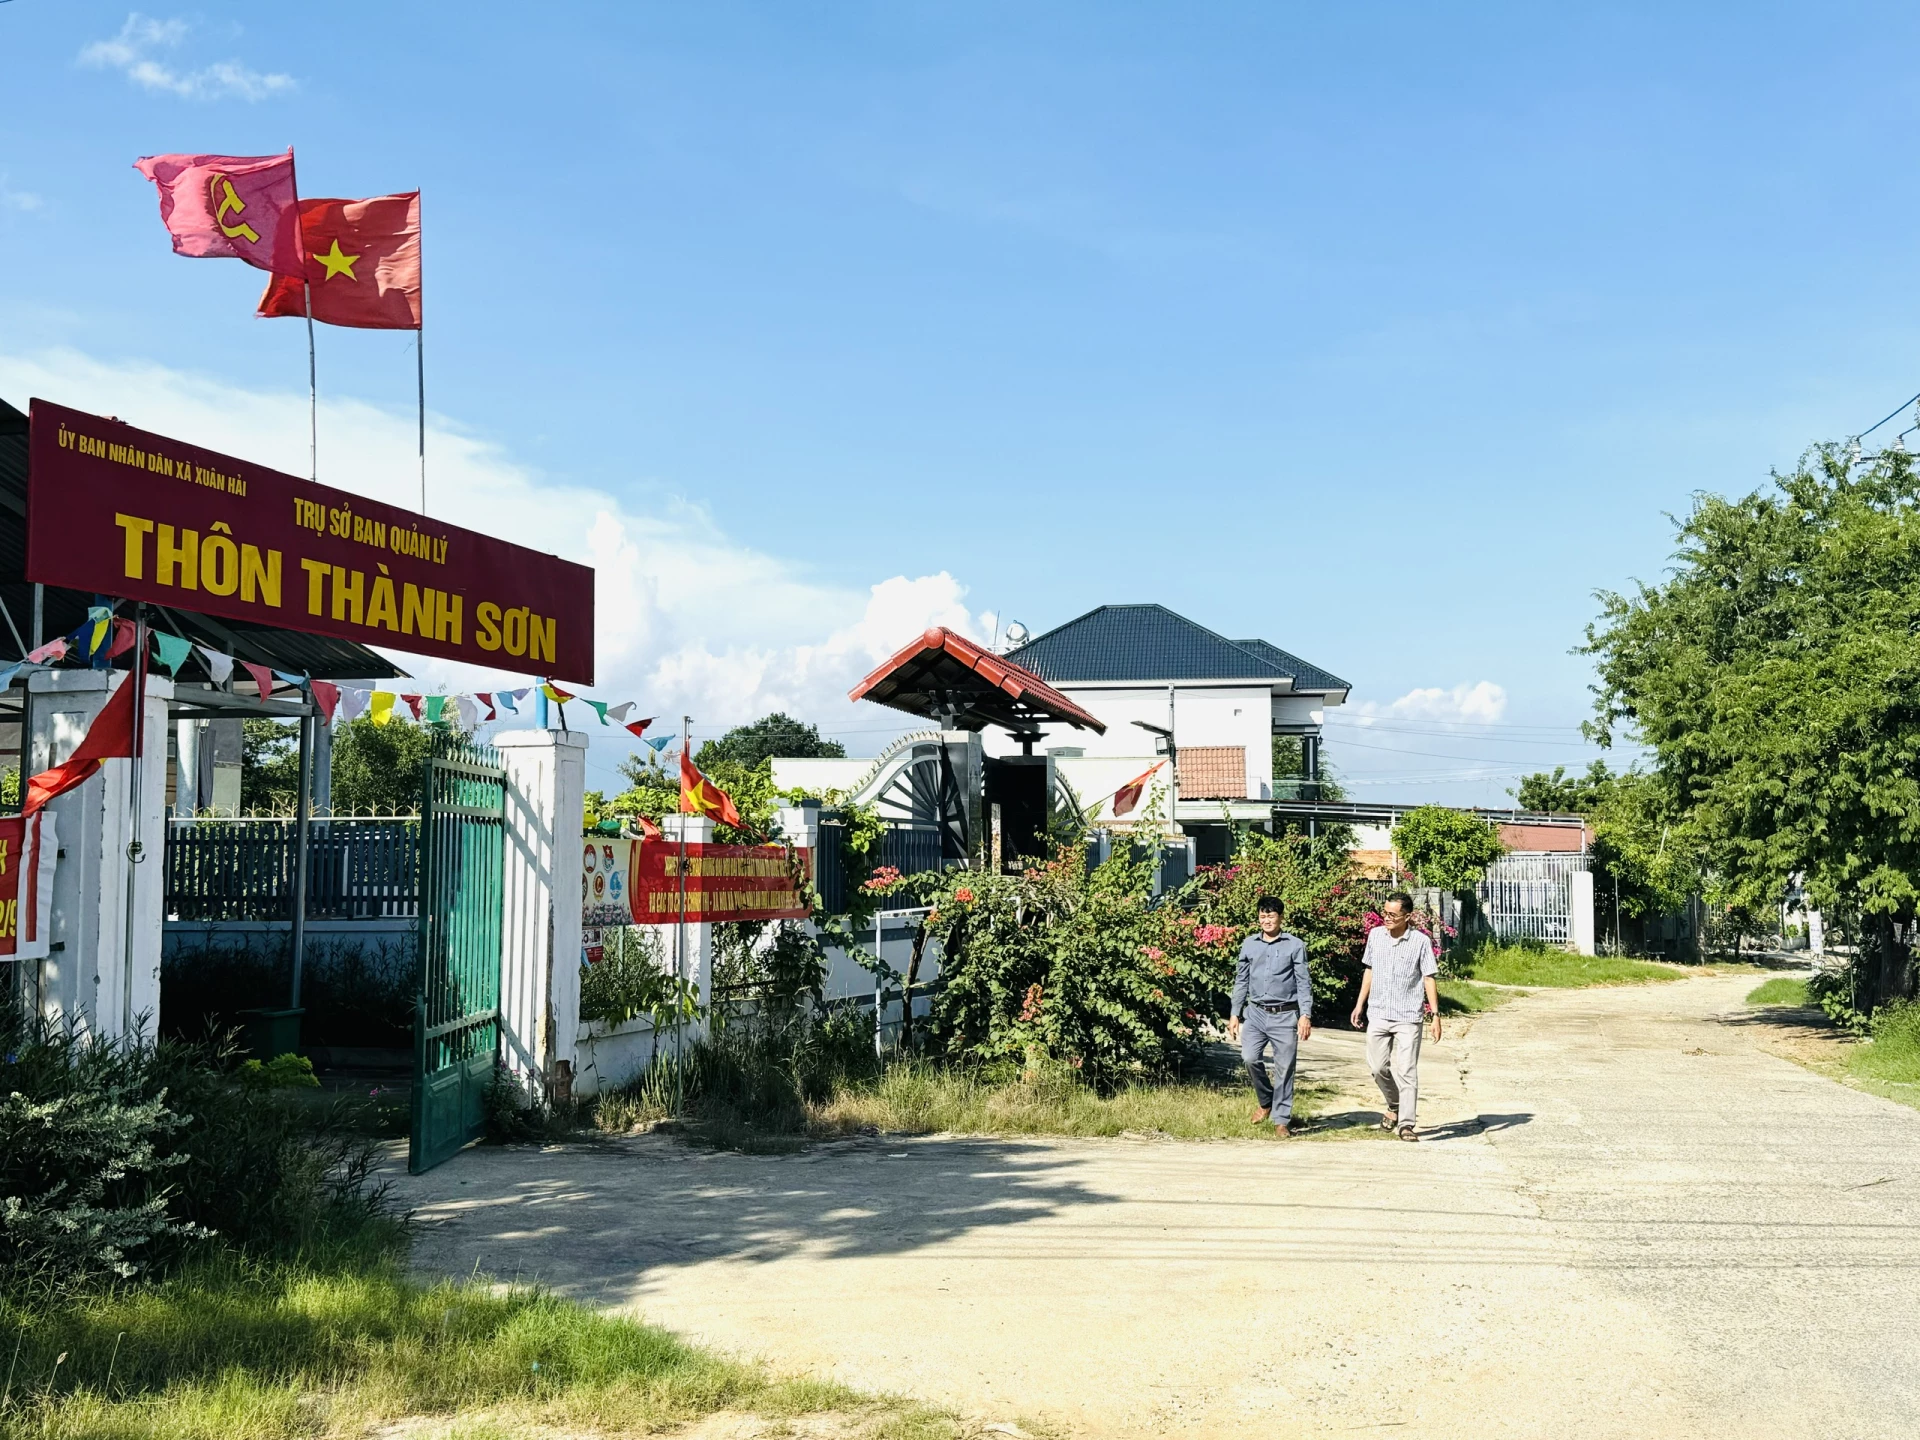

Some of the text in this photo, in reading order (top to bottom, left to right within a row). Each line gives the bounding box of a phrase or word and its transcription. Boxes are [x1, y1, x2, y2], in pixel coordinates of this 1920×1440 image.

[58, 423, 247, 497] ỦY BAN NHÂN DÂN XÃ XUÂN HẢI
[293, 497, 449, 565] TRỤ SỞ BAN QUẢN LÝ
[115, 512, 556, 664] THÔN THÀNH SƠN
